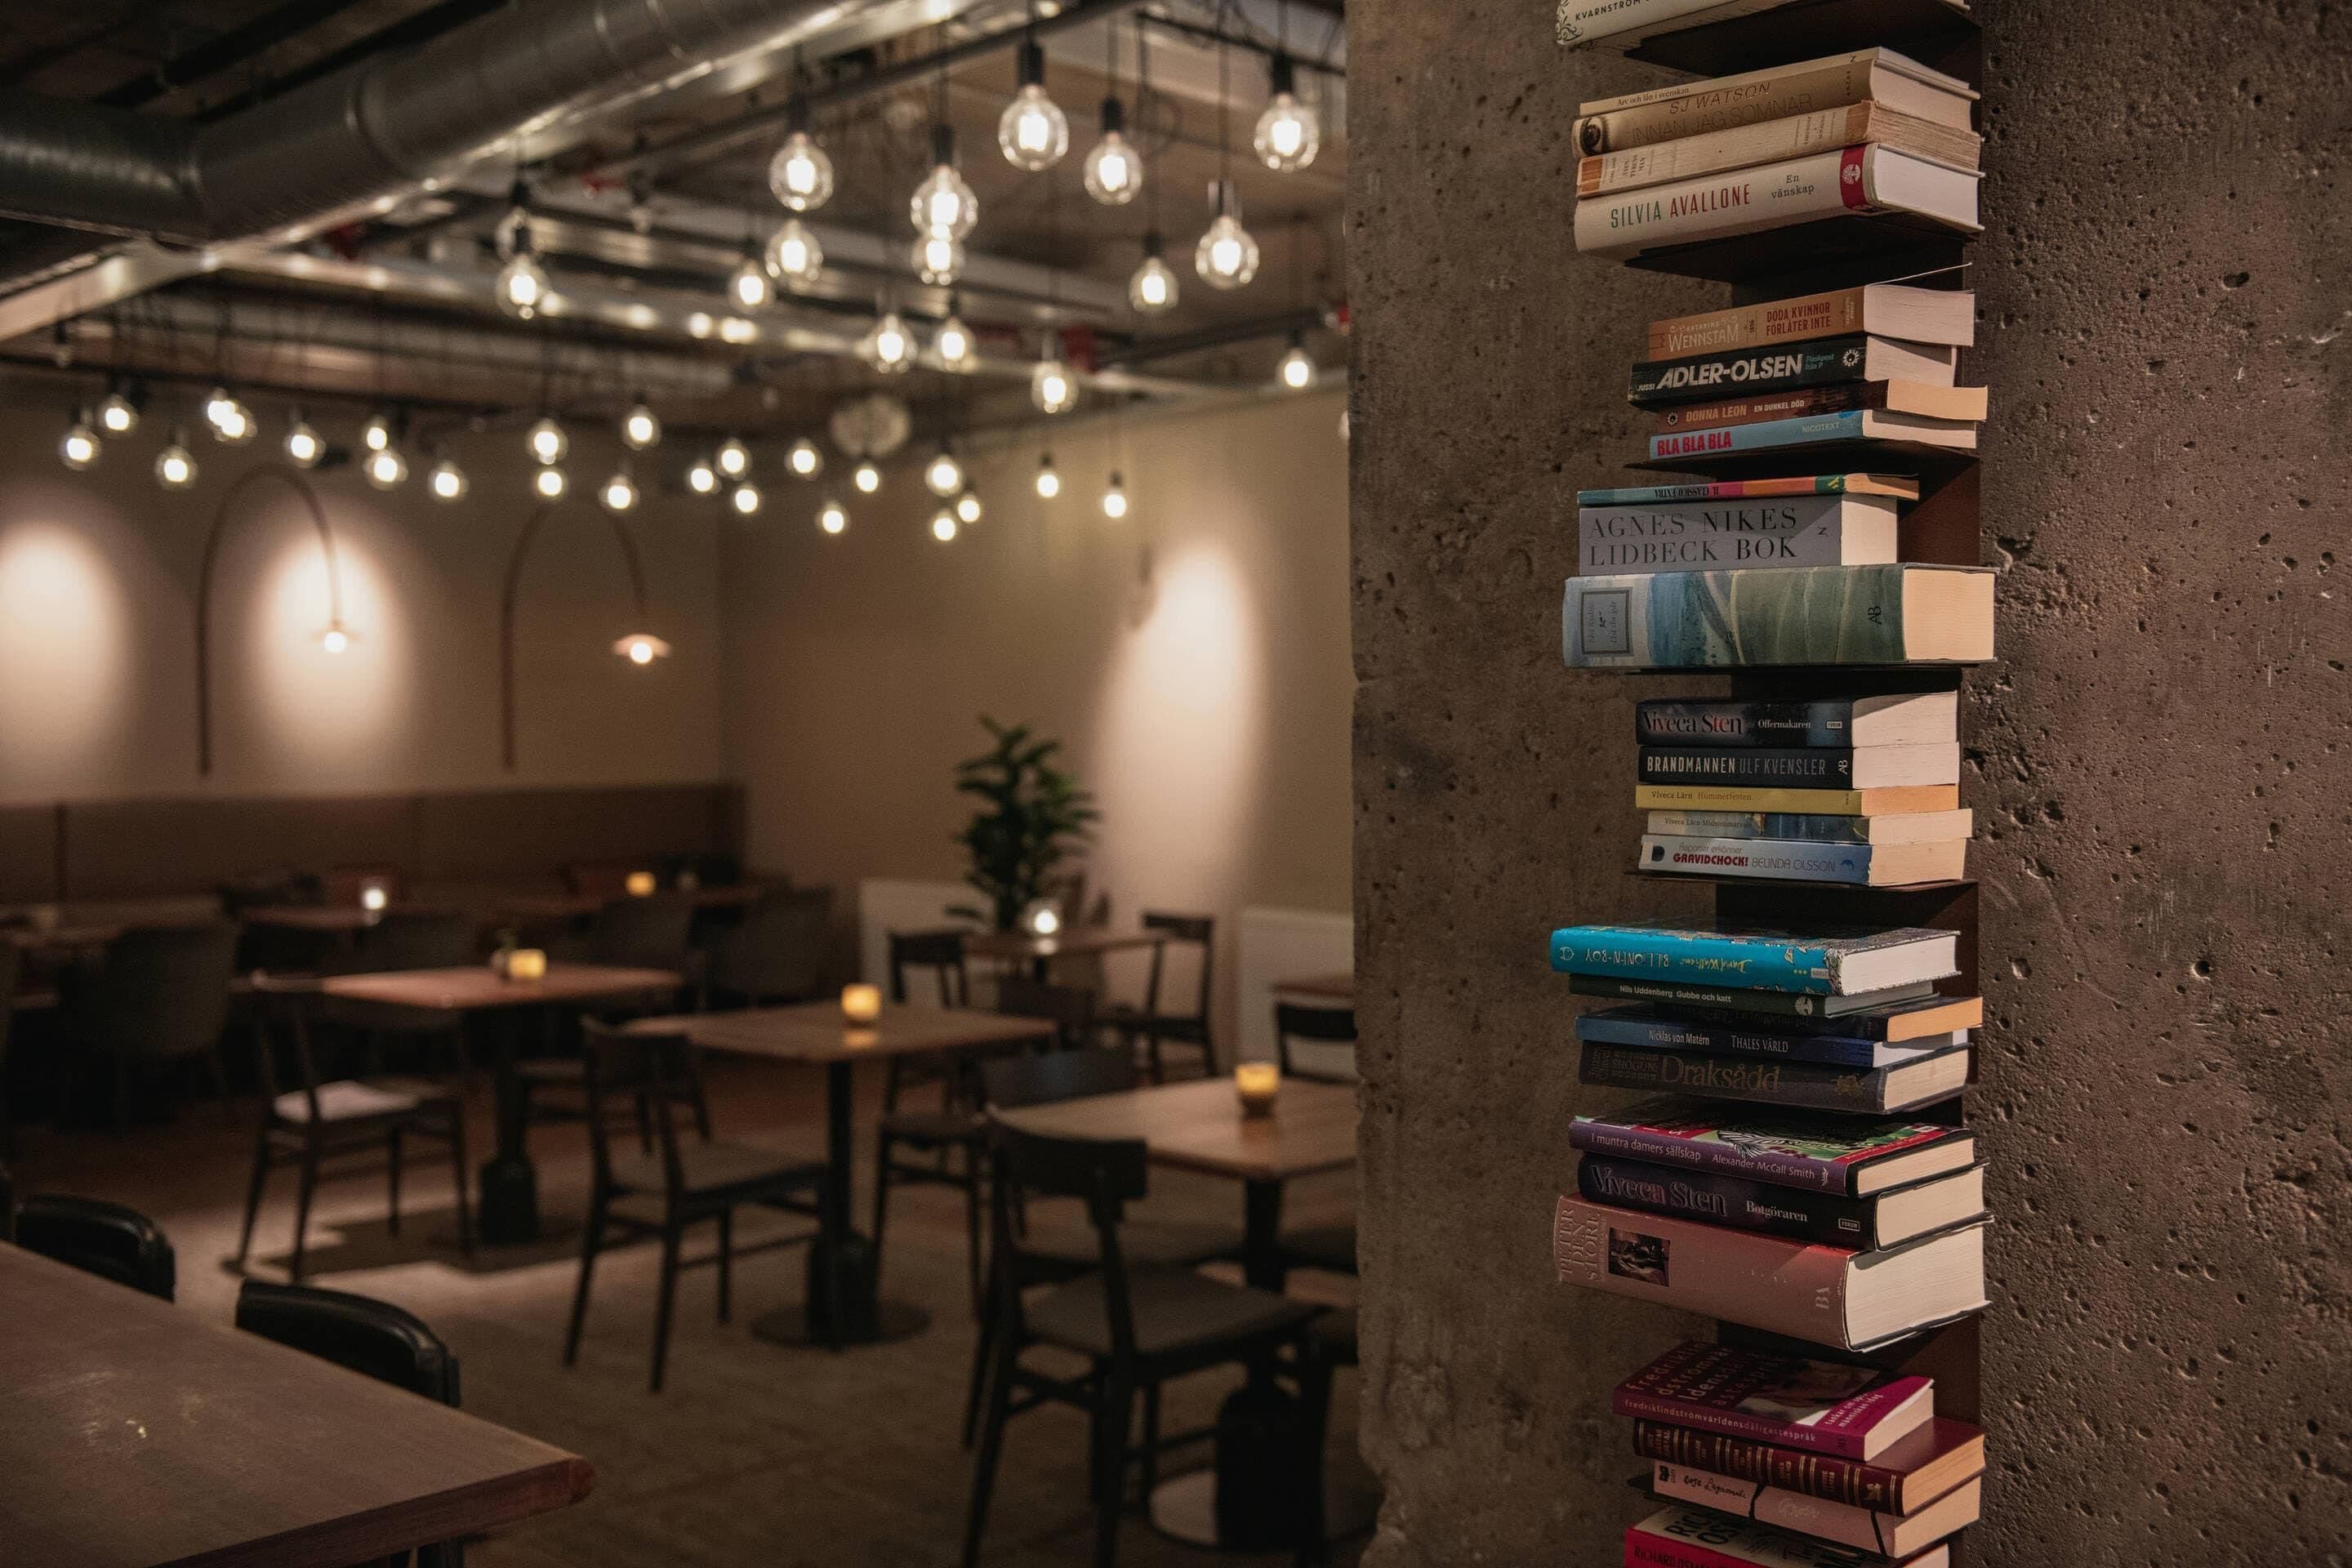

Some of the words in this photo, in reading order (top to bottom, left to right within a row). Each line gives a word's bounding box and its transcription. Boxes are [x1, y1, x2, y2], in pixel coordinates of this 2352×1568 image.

[1617, 98, 1629, 107] Arv
[1630, 95, 1642, 104] och
[1659, 87, 1690, 99] svenskan
[1670, 100, 1690, 114] SJ
[1695, 82, 1771, 109] WATSON
[1785, 174, 1800, 185] En
[1771, 185, 1815, 199] vänskap
[1610, 201, 1662, 229] SILVIA
[1670, 183, 1751, 218] AVALLONE
[1766, 306, 1788, 323] DÖDA
[1791, 301, 1831, 318] KVINNOR
[1766, 318, 1808, 336] FÖRLÅTER
[1811, 315, 1831, 329] INTE
[1668, 323, 1739, 353] WENNSTAM
[1806, 353, 1835, 363] Flaskpost
[1637, 383, 1655, 392] JUSSI
[1656, 354, 1803, 390] ADLER-OLSEN
[1686, 408, 1718, 422] DONNA
[1722, 405, 1747, 418] LEON
[1764, 402, 1789, 412] DUNKEL
[1790, 399, 1805, 408] DÖD
[1657, 438, 1680, 457] BLA
[1683, 434, 1705, 453] BLA
[1708, 431, 1732, 450] BLA
[1588, 514, 1686, 538] AGNES
[1702, 506, 1797, 532] NIKES
[1589, 540, 1719, 566] LIDBECK
[1736, 536, 1797, 560] BOK
[1643, 710, 1697, 733] Viveca
[1701, 712, 1743, 735] Sten
[1757, 719, 1811, 729] Offermakaren
[1646, 755, 1735, 774] BRANDMANNEN
[1740, 758, 1761, 774] ULF
[1764, 758, 1826, 775] KVENSLER
[1651, 790, 1674, 800] Viveca
[1676, 791, 1693, 800] Lärn
[1698, 791, 1752, 801] Hummerfesten
[1664, 817, 1685, 826] Viveca
[1686, 817, 1701, 826] Lärn
[1678, 842, 1709, 853] Reporter
[1711, 844, 1744, 853] erkänner
[1673, 853, 1748, 867] GRAVIDCHOCK!
[1793, 858, 1837, 872] OLSSON
[1619, 984, 1633, 994] Nils
[1633, 985, 1673, 999] Uddenberg
[1676, 989, 1700, 1000] Gubbe
[1701, 992, 1716, 1001] och
[1717, 993, 1732, 1003] katt
[1648, 1029, 1671, 1041] Nicklas
[1673, 1034, 1685, 1044] von
[1685, 1031, 1710, 1046] Matérn
[1731, 1035, 1760, 1051] THALES
[1763, 1036, 1789, 1054] VÄRLD
[1660, 1054, 1780, 1094] Draksådd
[1597, 1134, 1628, 1149] muntra
[1630, 1138, 1664, 1155] damers
[1665, 1145, 1701, 1162] sällskap
[1712, 1154, 1756, 1169] Alexander
[1757, 1160, 1787, 1174] McCall
[1788, 1165, 1815, 1179] Smith
[1591, 1165, 1667, 1206] Viveca
[1669, 1181, 1728, 1218] Sten
[1745, 1200, 1808, 1223] Botgöraren
[1583, 1209, 1601, 1281] STORE
